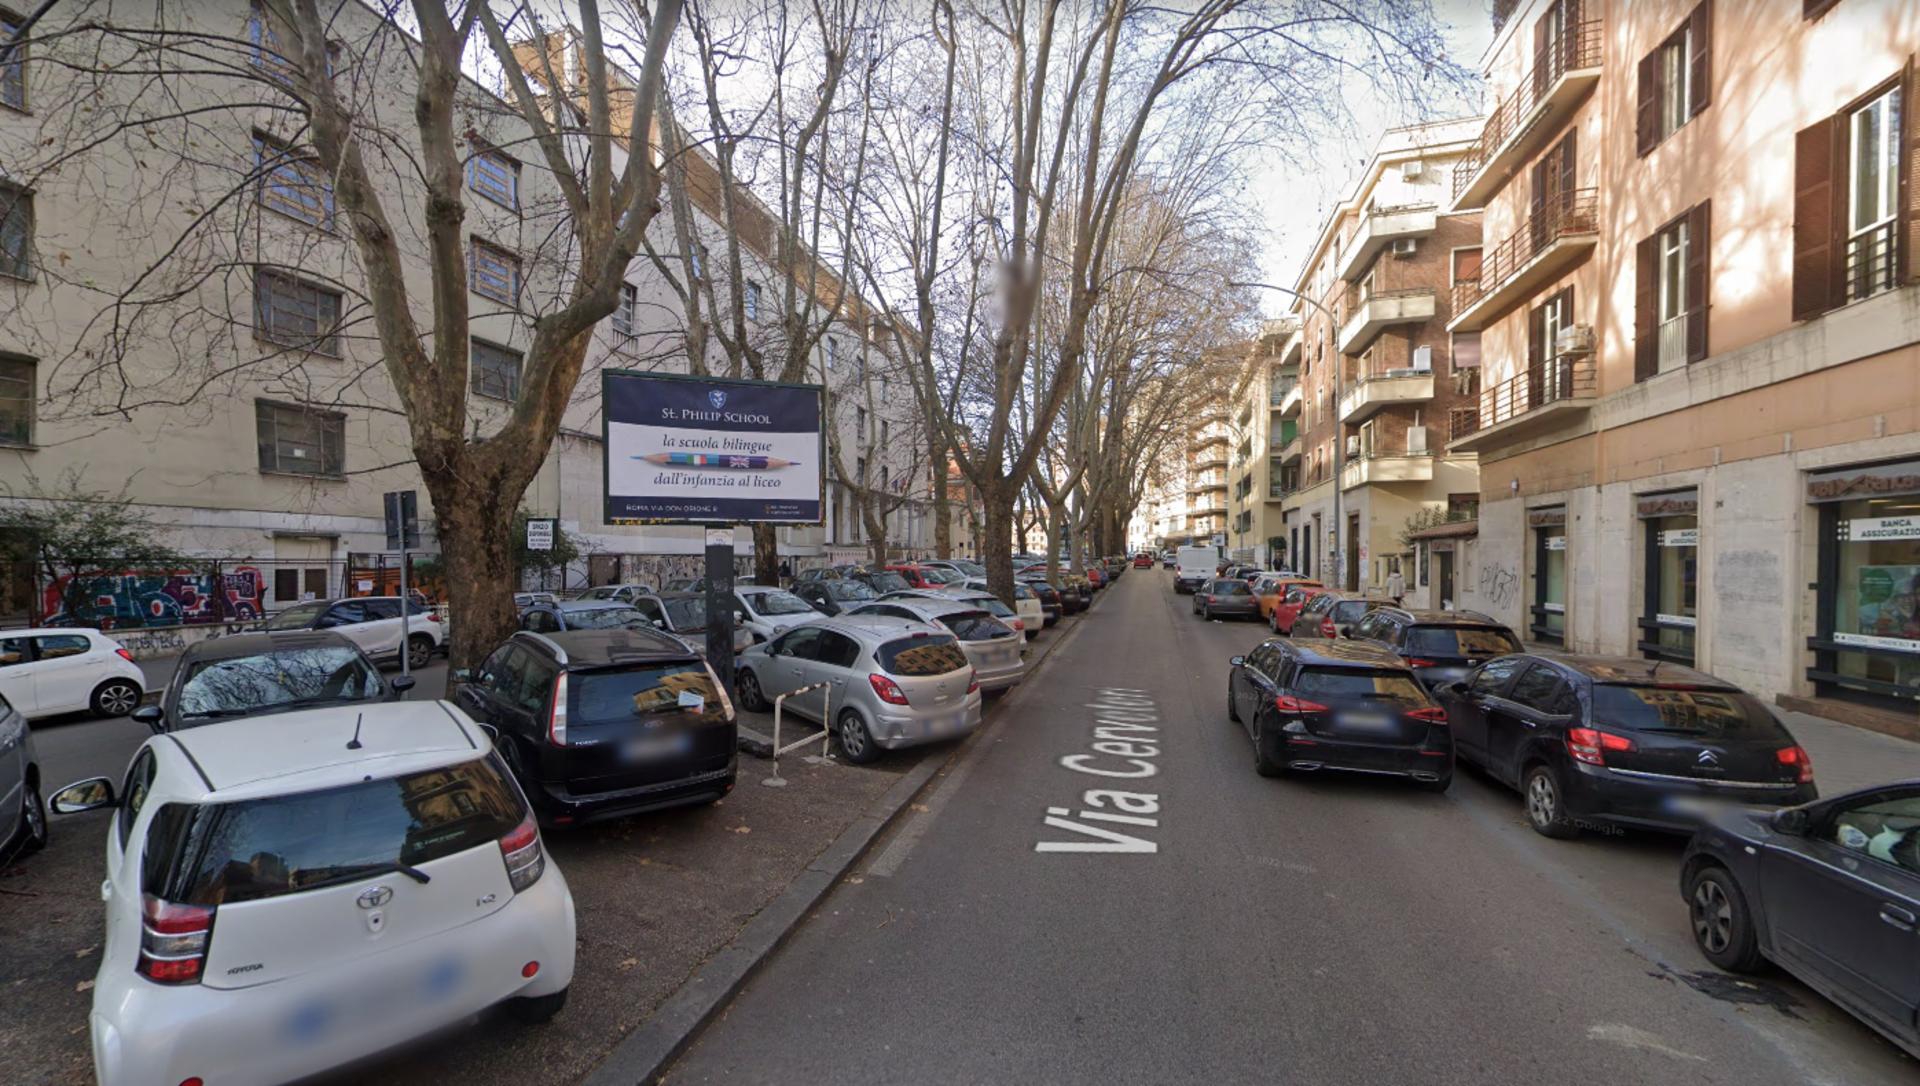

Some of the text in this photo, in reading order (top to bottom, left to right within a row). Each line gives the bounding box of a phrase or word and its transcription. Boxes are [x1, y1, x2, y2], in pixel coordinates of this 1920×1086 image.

[662, 408, 772, 425] St. PHILIP SCHOOL
[663, 434, 772, 454] la scuola bilingue
[738, 475, 751, 487] al
[753, 475, 782, 488] liceo
[1881, 519, 1912, 527] BANCA
[227, 963, 264, 975] TOYOTA
